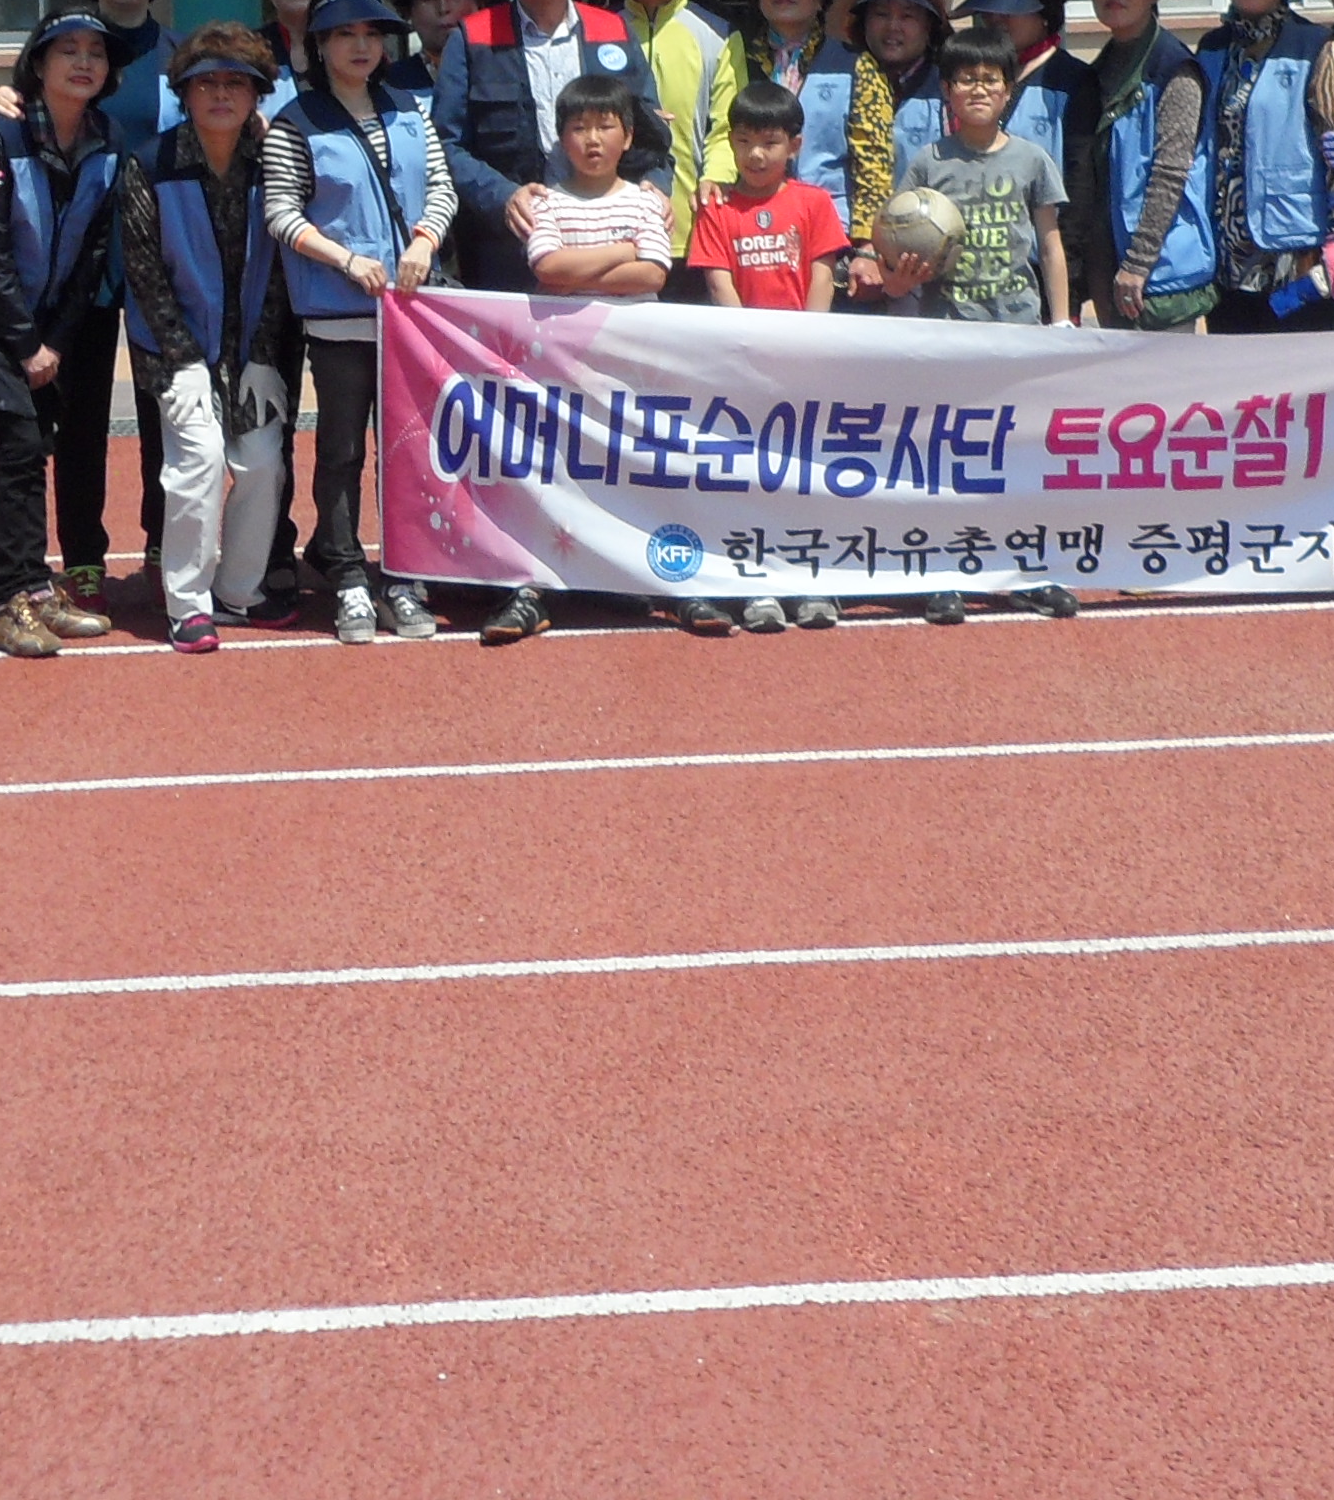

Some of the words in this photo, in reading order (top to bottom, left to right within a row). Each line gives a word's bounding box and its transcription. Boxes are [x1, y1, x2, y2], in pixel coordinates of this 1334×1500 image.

[437, 379, 1016, 498] 어머니포순이봉사단
[656, 545, 693, 564] KFF
[720, 524, 1107, 579] 한국자유총연맹
